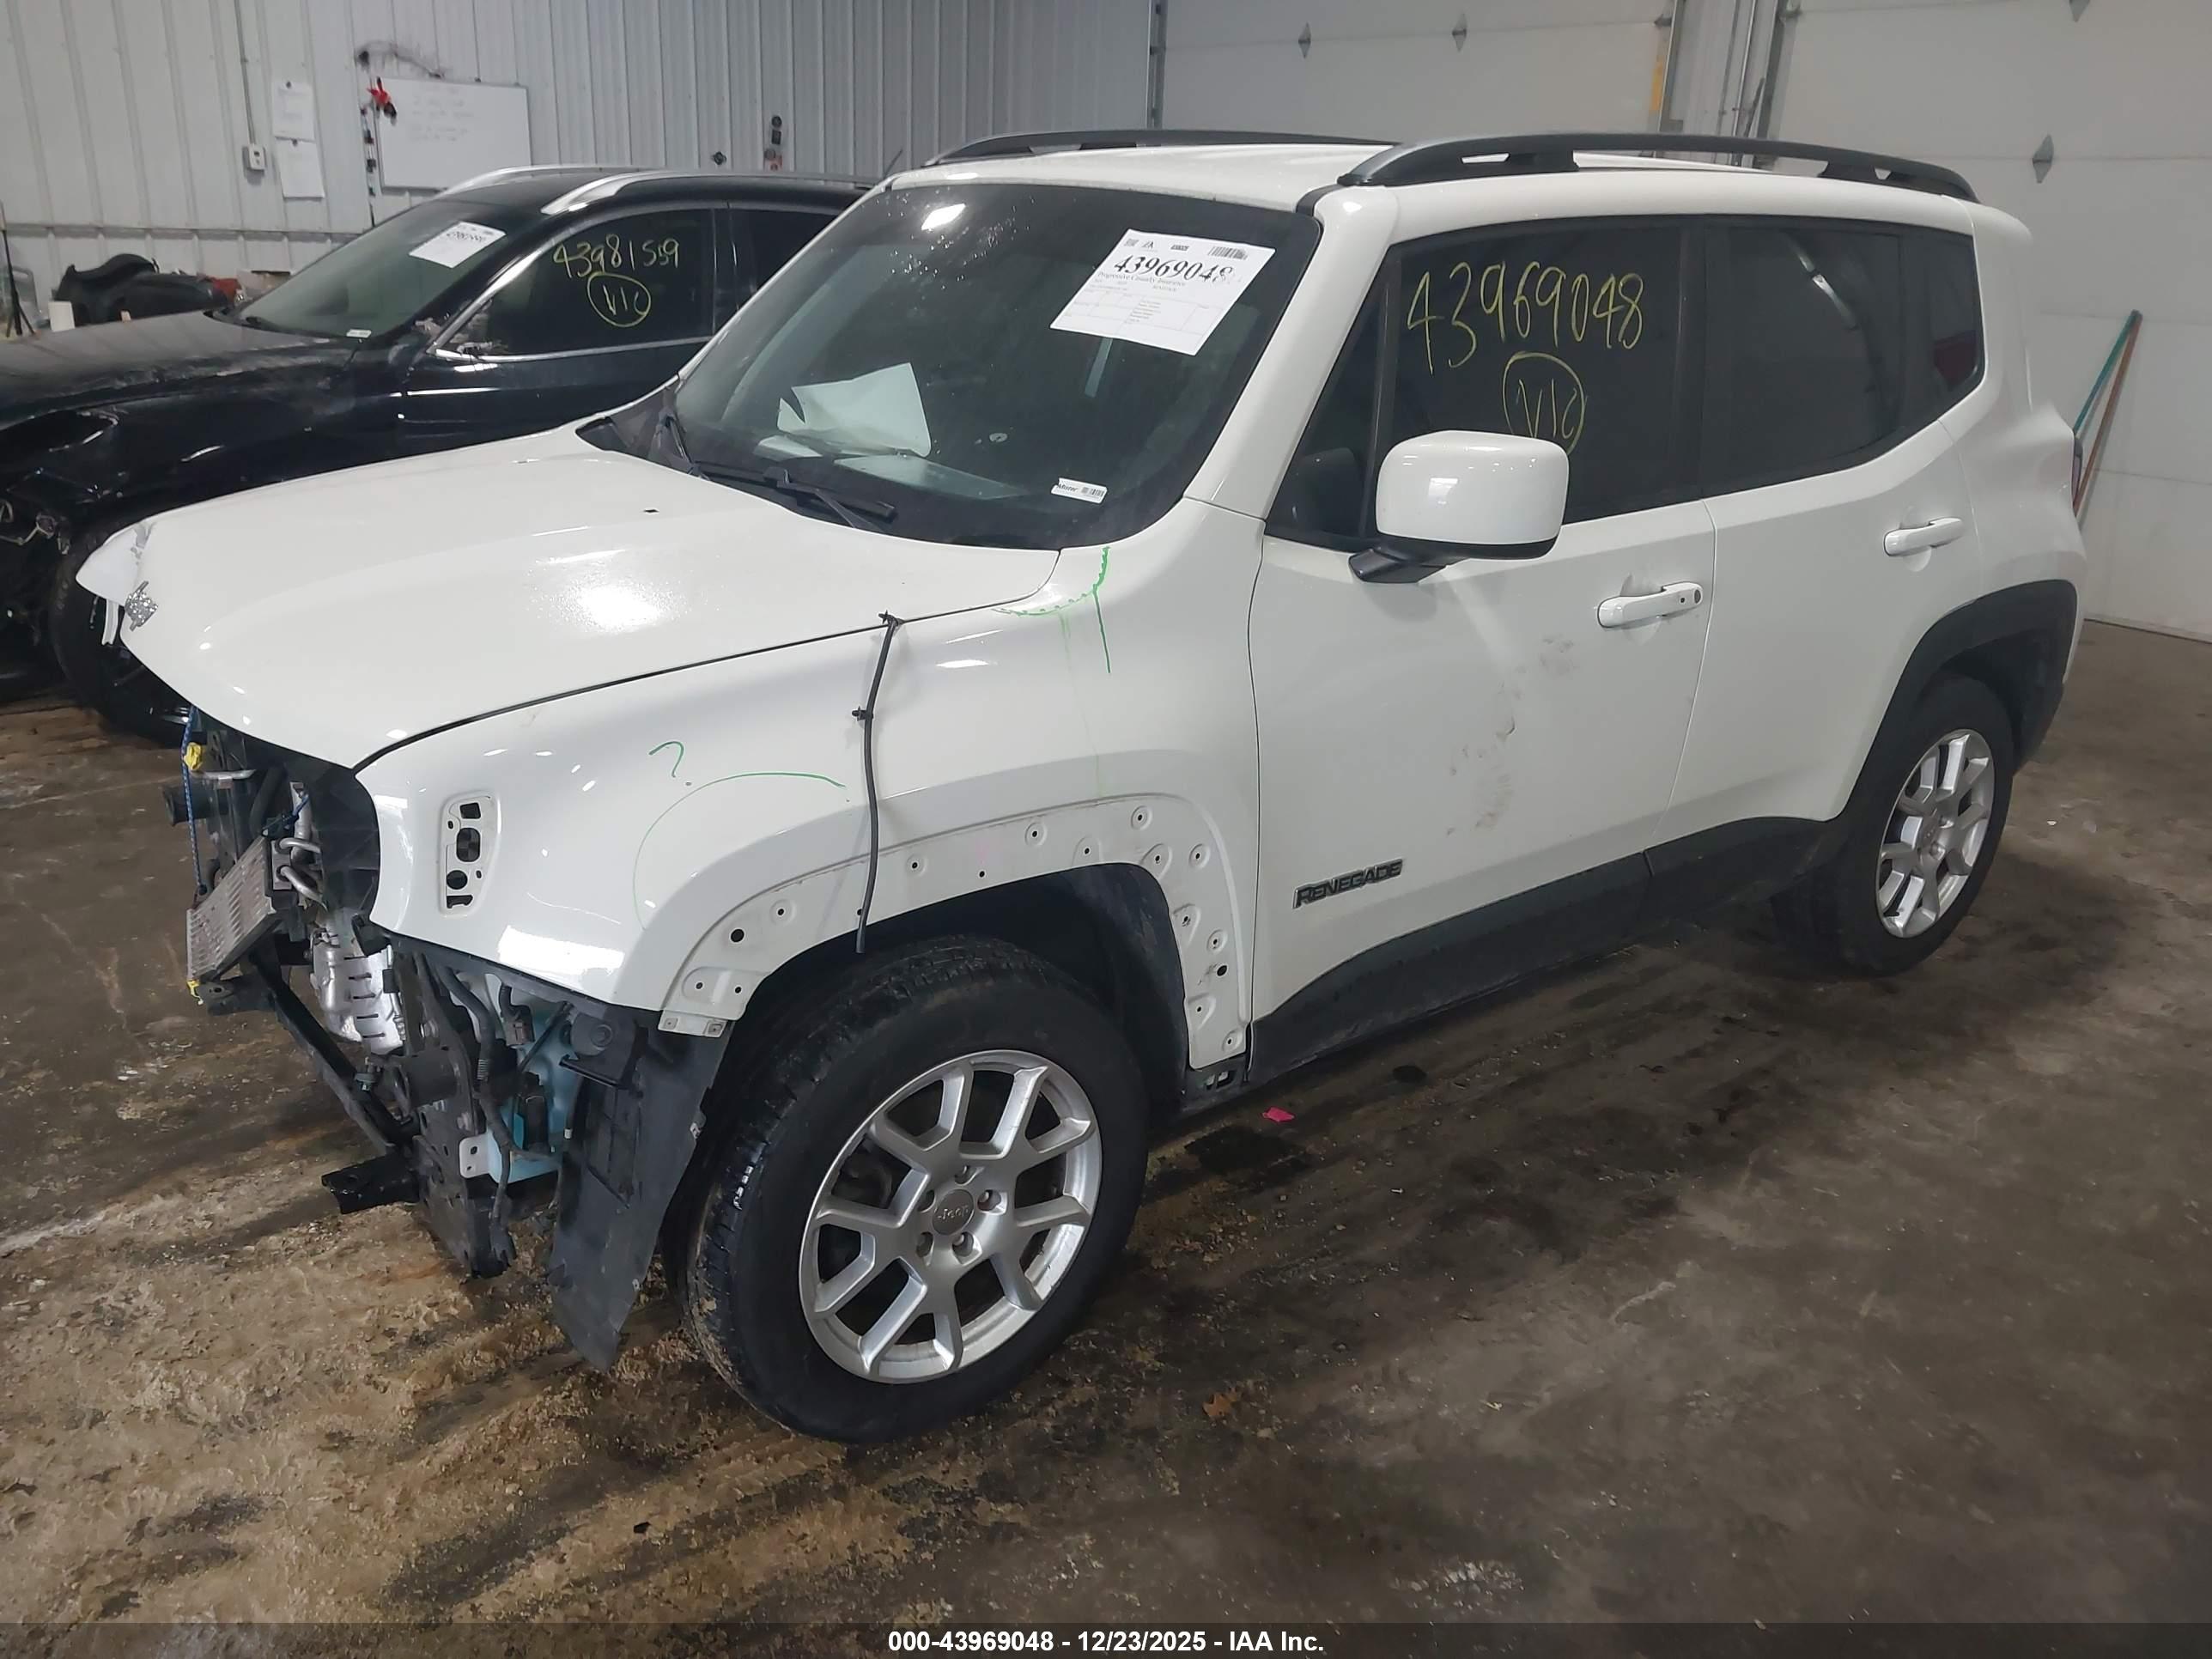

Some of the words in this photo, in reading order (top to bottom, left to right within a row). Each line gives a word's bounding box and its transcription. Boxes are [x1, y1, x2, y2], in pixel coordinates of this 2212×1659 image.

[552, 234, 679, 278] 43981559
[1407, 261, 1644, 375] 43969048
[648, 741, 692, 787] ?
[1291, 858, 1403, 908] RENEGADE
